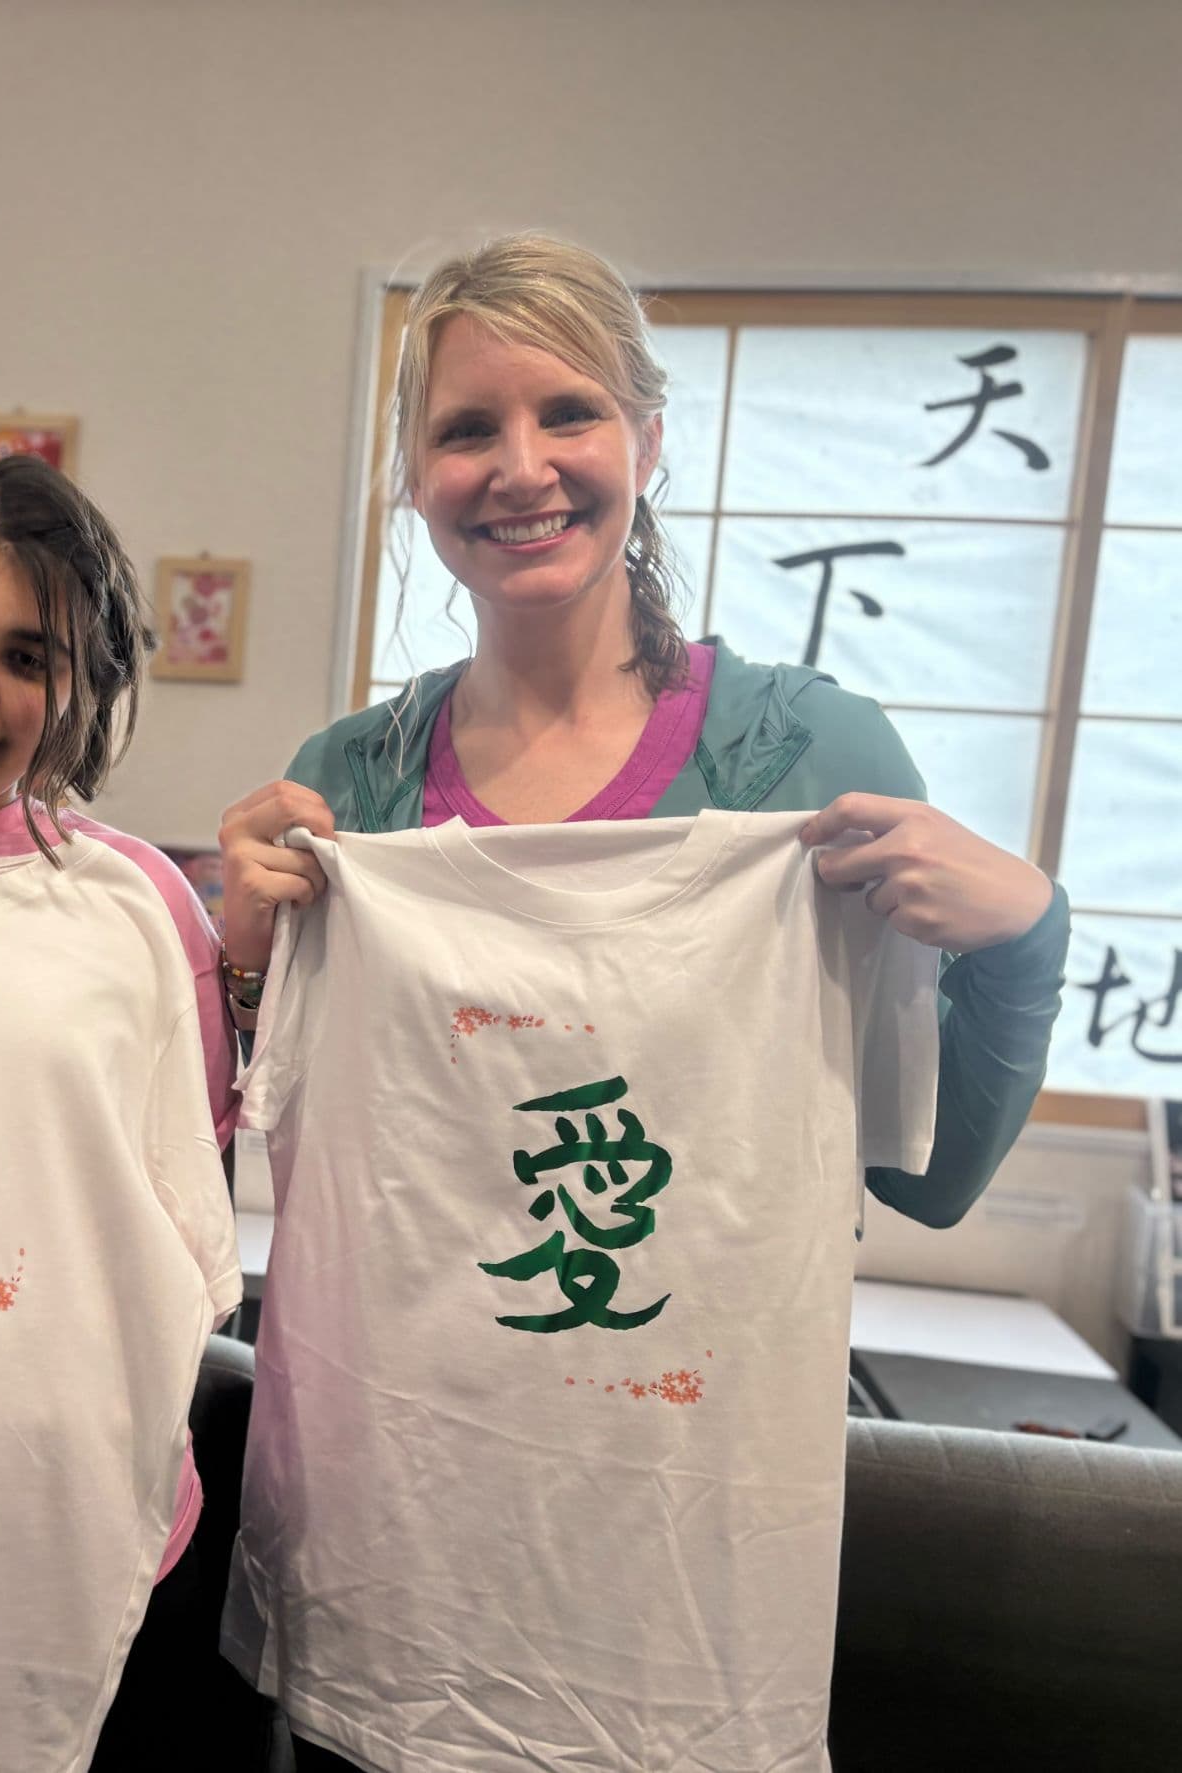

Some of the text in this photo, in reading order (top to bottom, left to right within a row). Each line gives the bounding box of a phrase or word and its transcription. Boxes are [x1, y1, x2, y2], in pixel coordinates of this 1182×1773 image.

[772, 343, 1051, 668] 天 下
[477, 1075, 673, 1334] 愛
